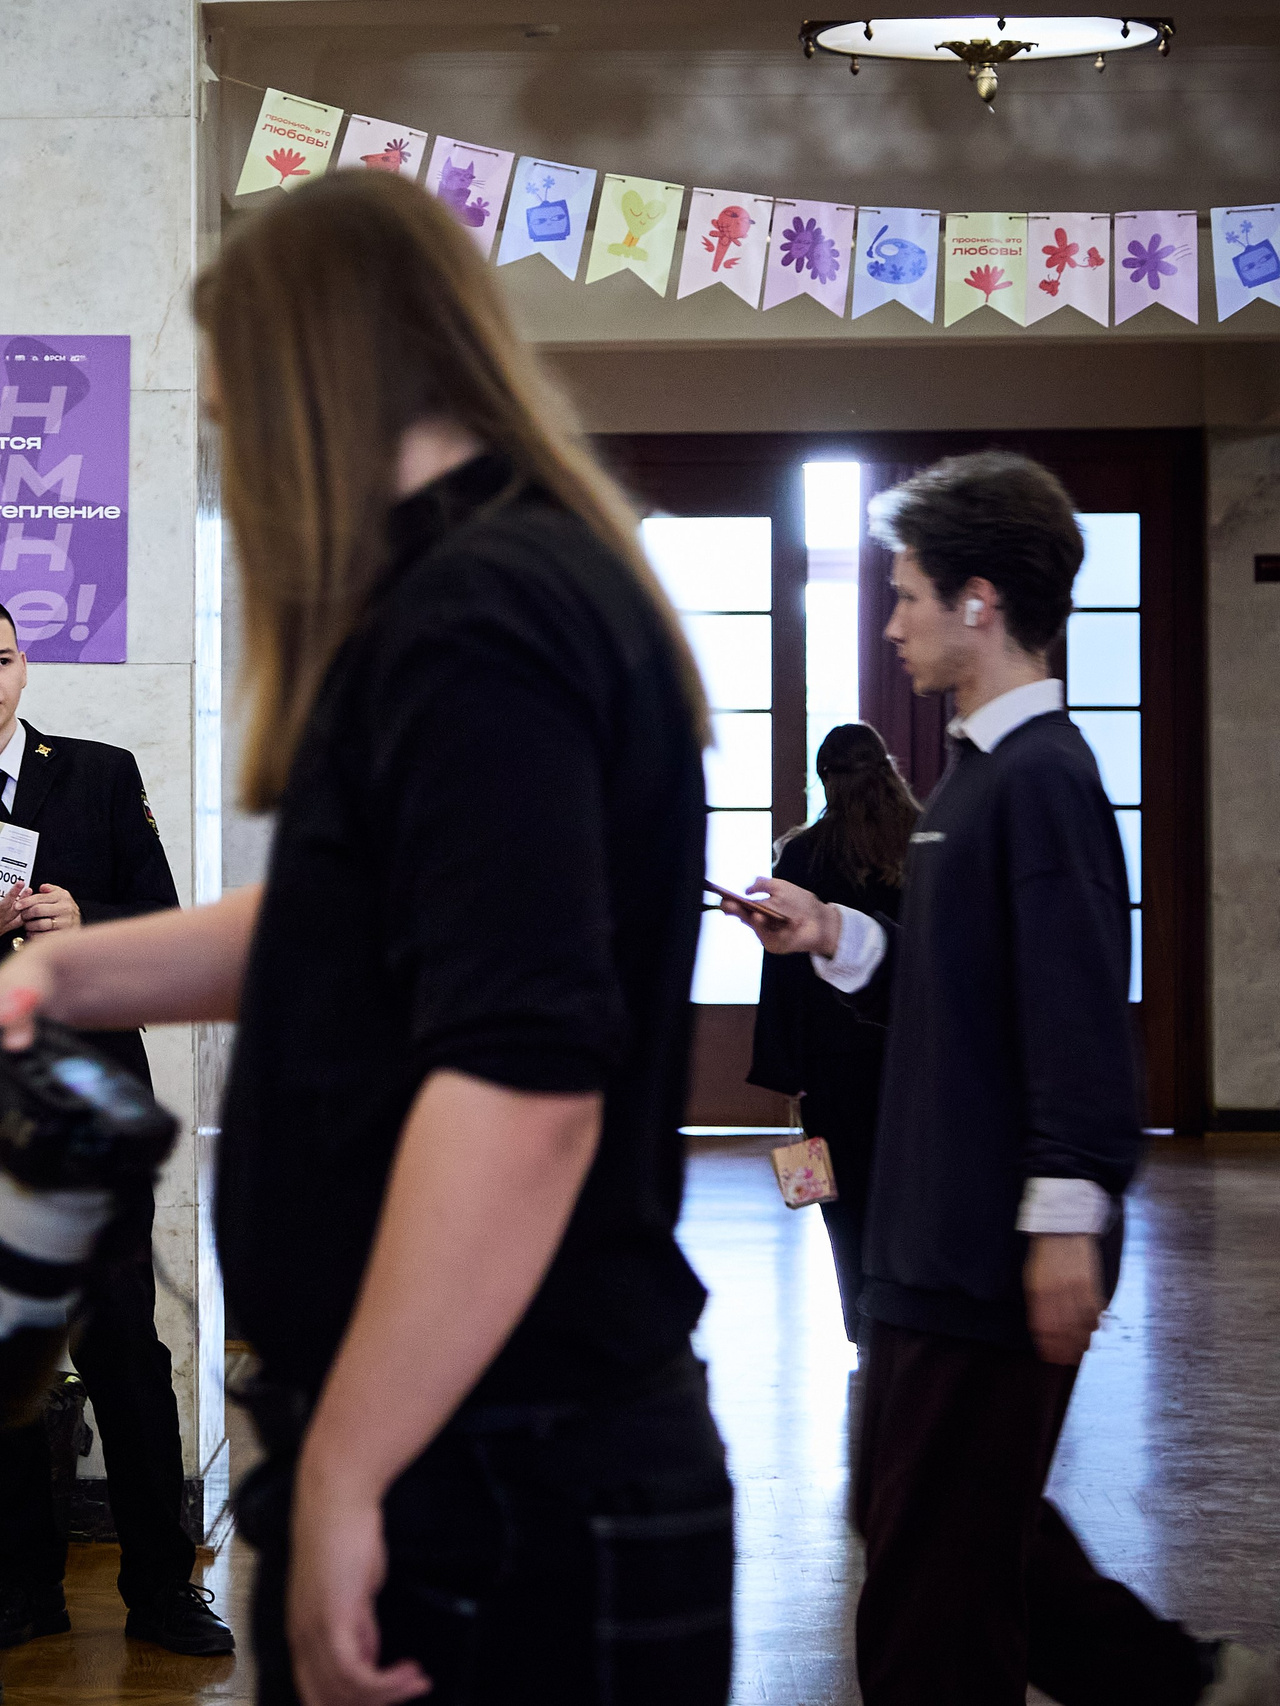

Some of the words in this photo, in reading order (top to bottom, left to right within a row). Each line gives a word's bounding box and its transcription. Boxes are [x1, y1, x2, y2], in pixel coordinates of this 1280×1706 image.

[261, 123, 329, 149] любовь!
[265, 113, 312, 132] проснись,
[314, 128, 331, 137] это
[952, 245, 1023, 256] любовь!
